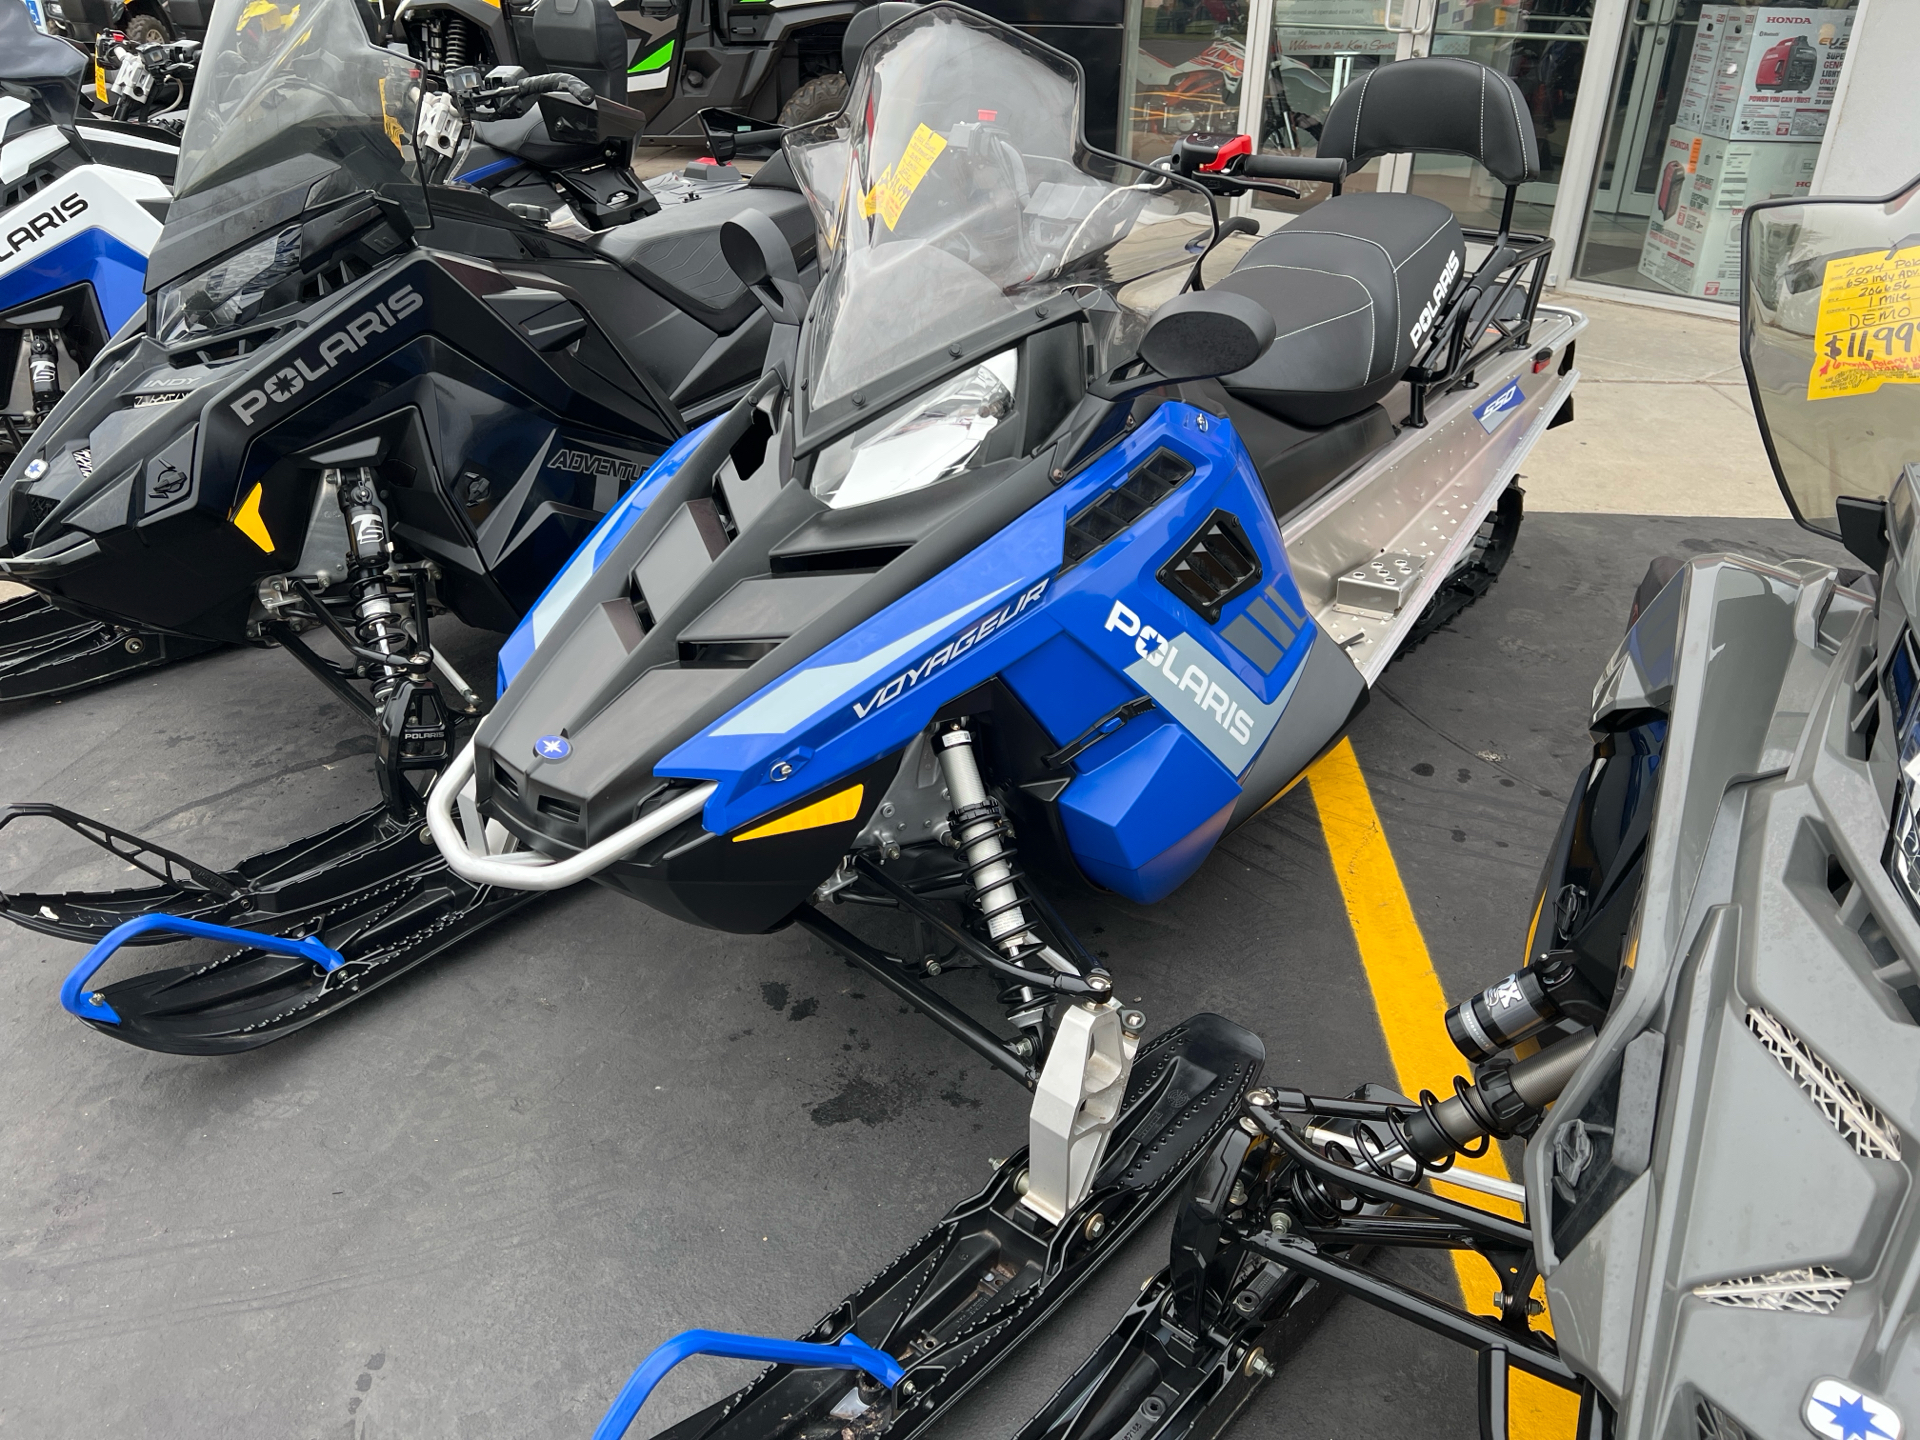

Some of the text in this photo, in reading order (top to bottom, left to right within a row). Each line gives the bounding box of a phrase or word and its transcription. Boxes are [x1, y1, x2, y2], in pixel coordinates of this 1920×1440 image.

[1766, 16, 1812, 25] HONDA
[1288, 40, 1322, 51] Welcome
[1323, 41, 1332, 50] to
[1332, 41, 1344, 50] the
[1346, 40, 1368, 52] Ken's
[1669, 139, 1689, 152] HONDA
[1846, 262, 1885, 277] 2024
[1846, 277, 1869, 288] 650
[1872, 272, 1895, 283] Indy
[1858, 280, 1911, 297] 206656
[1409, 249, 1461, 350] POLARIS
[1869, 296, 1873, 308] 1
[1849, 307, 1911, 330] DEMO
[1824, 322, 1920, 361] $11,99
[230, 285, 425, 426] POLARIS
[143, 376, 203, 388] INDY
[852, 577, 1050, 719] VOYAGEUR
[1104, 599, 1255, 746] POLARIS
[404, 731, 445, 739] POLARIS
[1464, 1011, 1491, 1048] PERFORMANCE
